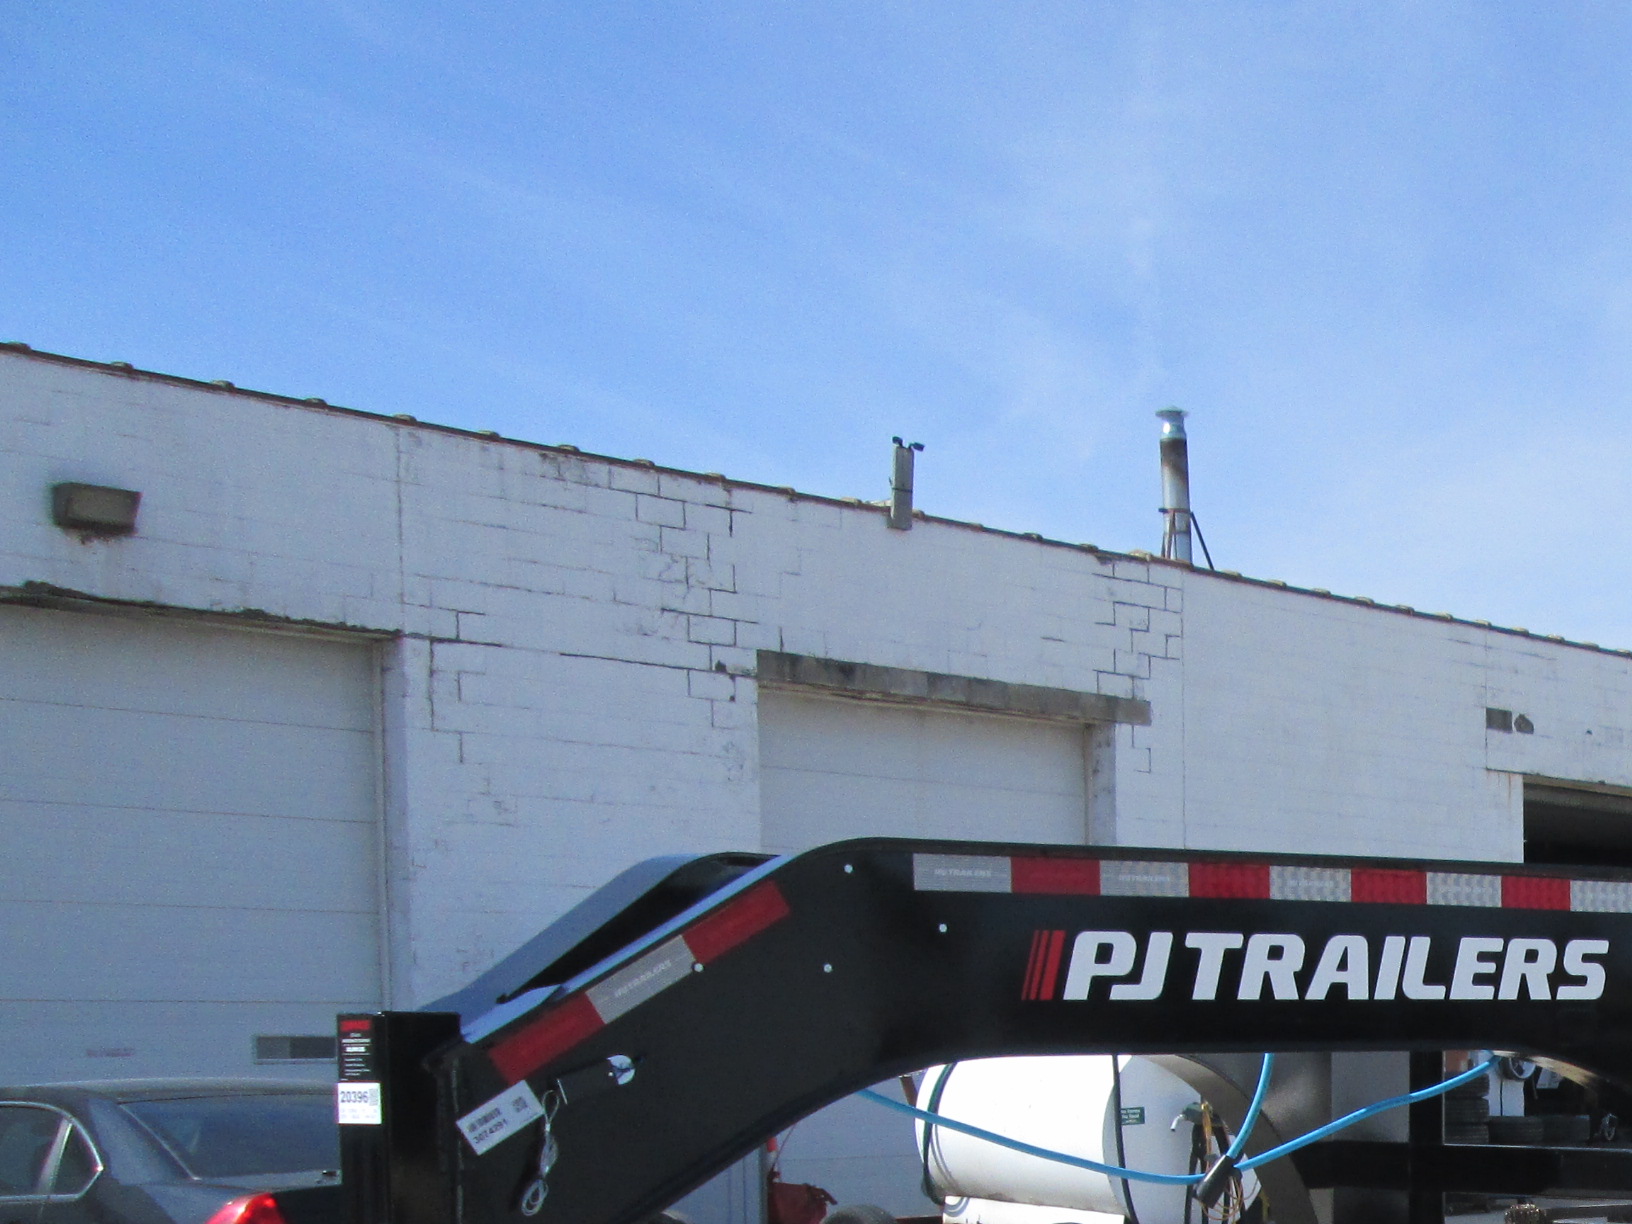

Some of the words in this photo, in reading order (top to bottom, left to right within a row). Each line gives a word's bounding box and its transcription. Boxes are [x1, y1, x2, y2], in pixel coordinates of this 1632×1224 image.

[1063, 930, 1174, 1001] PJ
[1185, 931, 1609, 1001] TRAILERS
[340, 1091, 369, 1104] 20396
